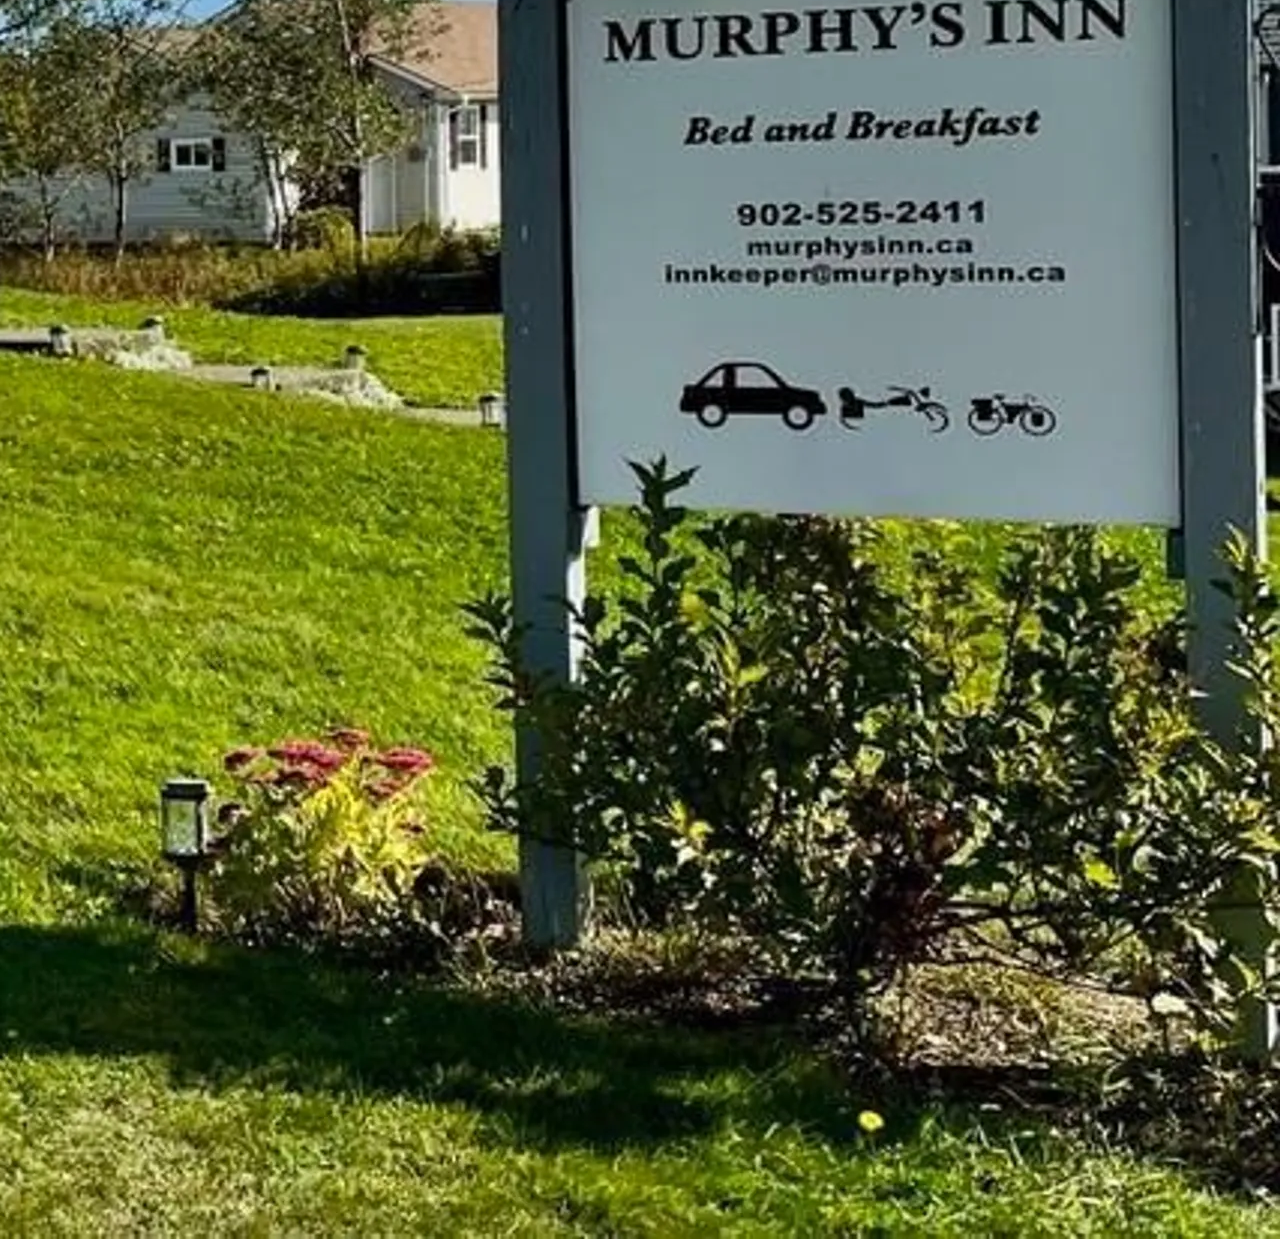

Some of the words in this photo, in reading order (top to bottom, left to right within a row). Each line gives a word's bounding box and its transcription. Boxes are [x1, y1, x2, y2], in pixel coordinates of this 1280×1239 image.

[602, 1, 966, 64] MURPHY'S
[683, 115, 756, 146] Bed
[763, 111, 838, 143] and
[845, 107, 1041, 147] Breakfast
[736, 199, 985, 227] 902-525-2411
[746, 235, 974, 260] murphysinn.ca
[665, 262, 1066, 288] innkeeper@murphysinn.ca
